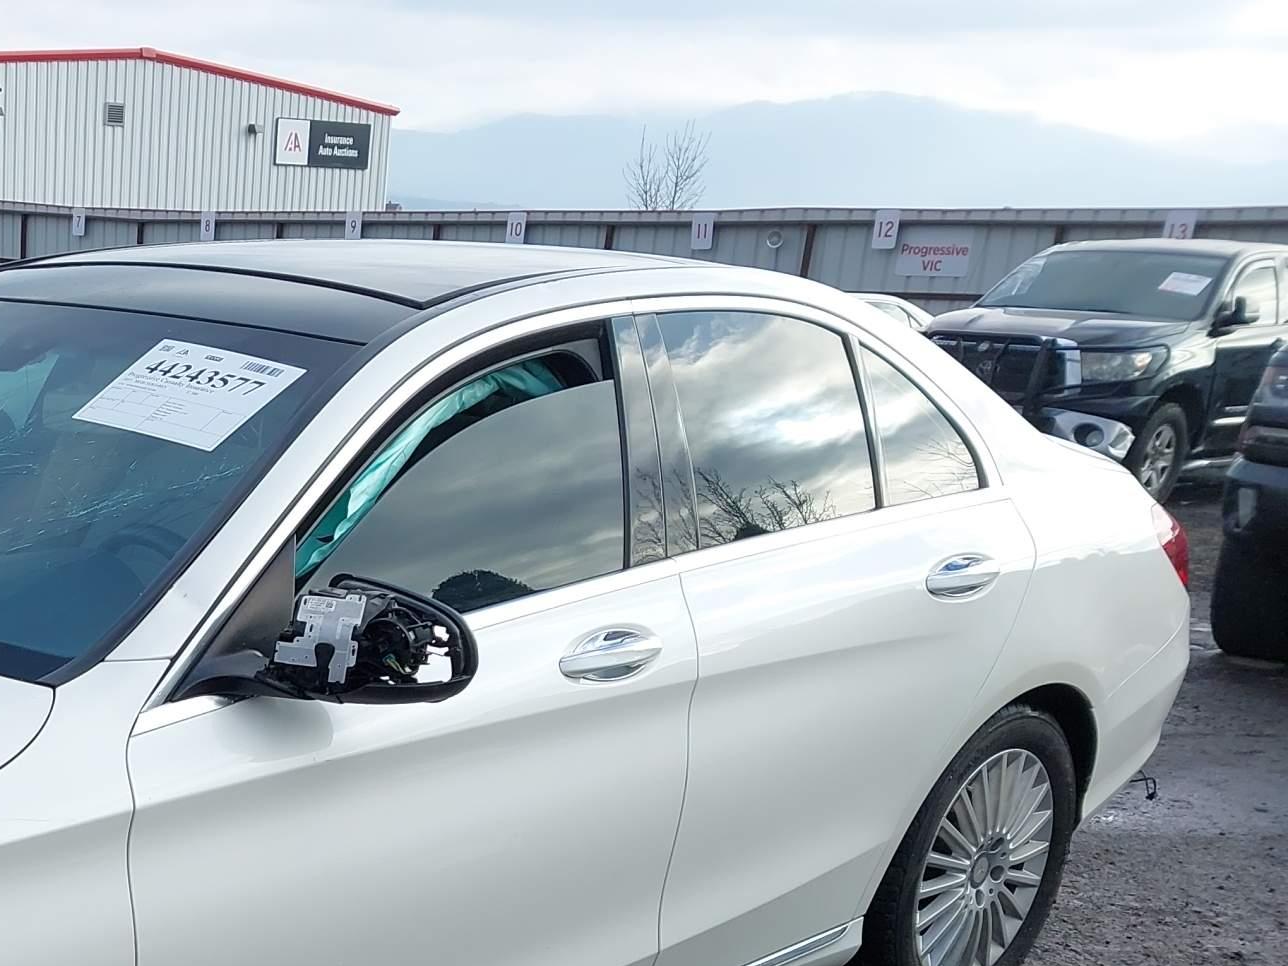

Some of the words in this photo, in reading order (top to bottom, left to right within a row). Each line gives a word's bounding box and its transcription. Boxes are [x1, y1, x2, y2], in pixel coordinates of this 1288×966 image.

[324, 133, 354, 145] Insurance
[318, 145, 332, 156] Auto
[333, 145, 359, 157] Auctions
[76, 215, 81, 228] 7
[204, 219, 211, 232] 8
[350, 219, 357, 234] 9
[510, 222, 522, 236] 10
[697, 223, 707, 239] 11
[877, 221, 894, 238] 12
[1168, 223, 1188, 239] 13
[901, 243, 969, 257] Progressive
[921, 260, 943, 271] VIC
[145, 359, 266, 396] 44243577
